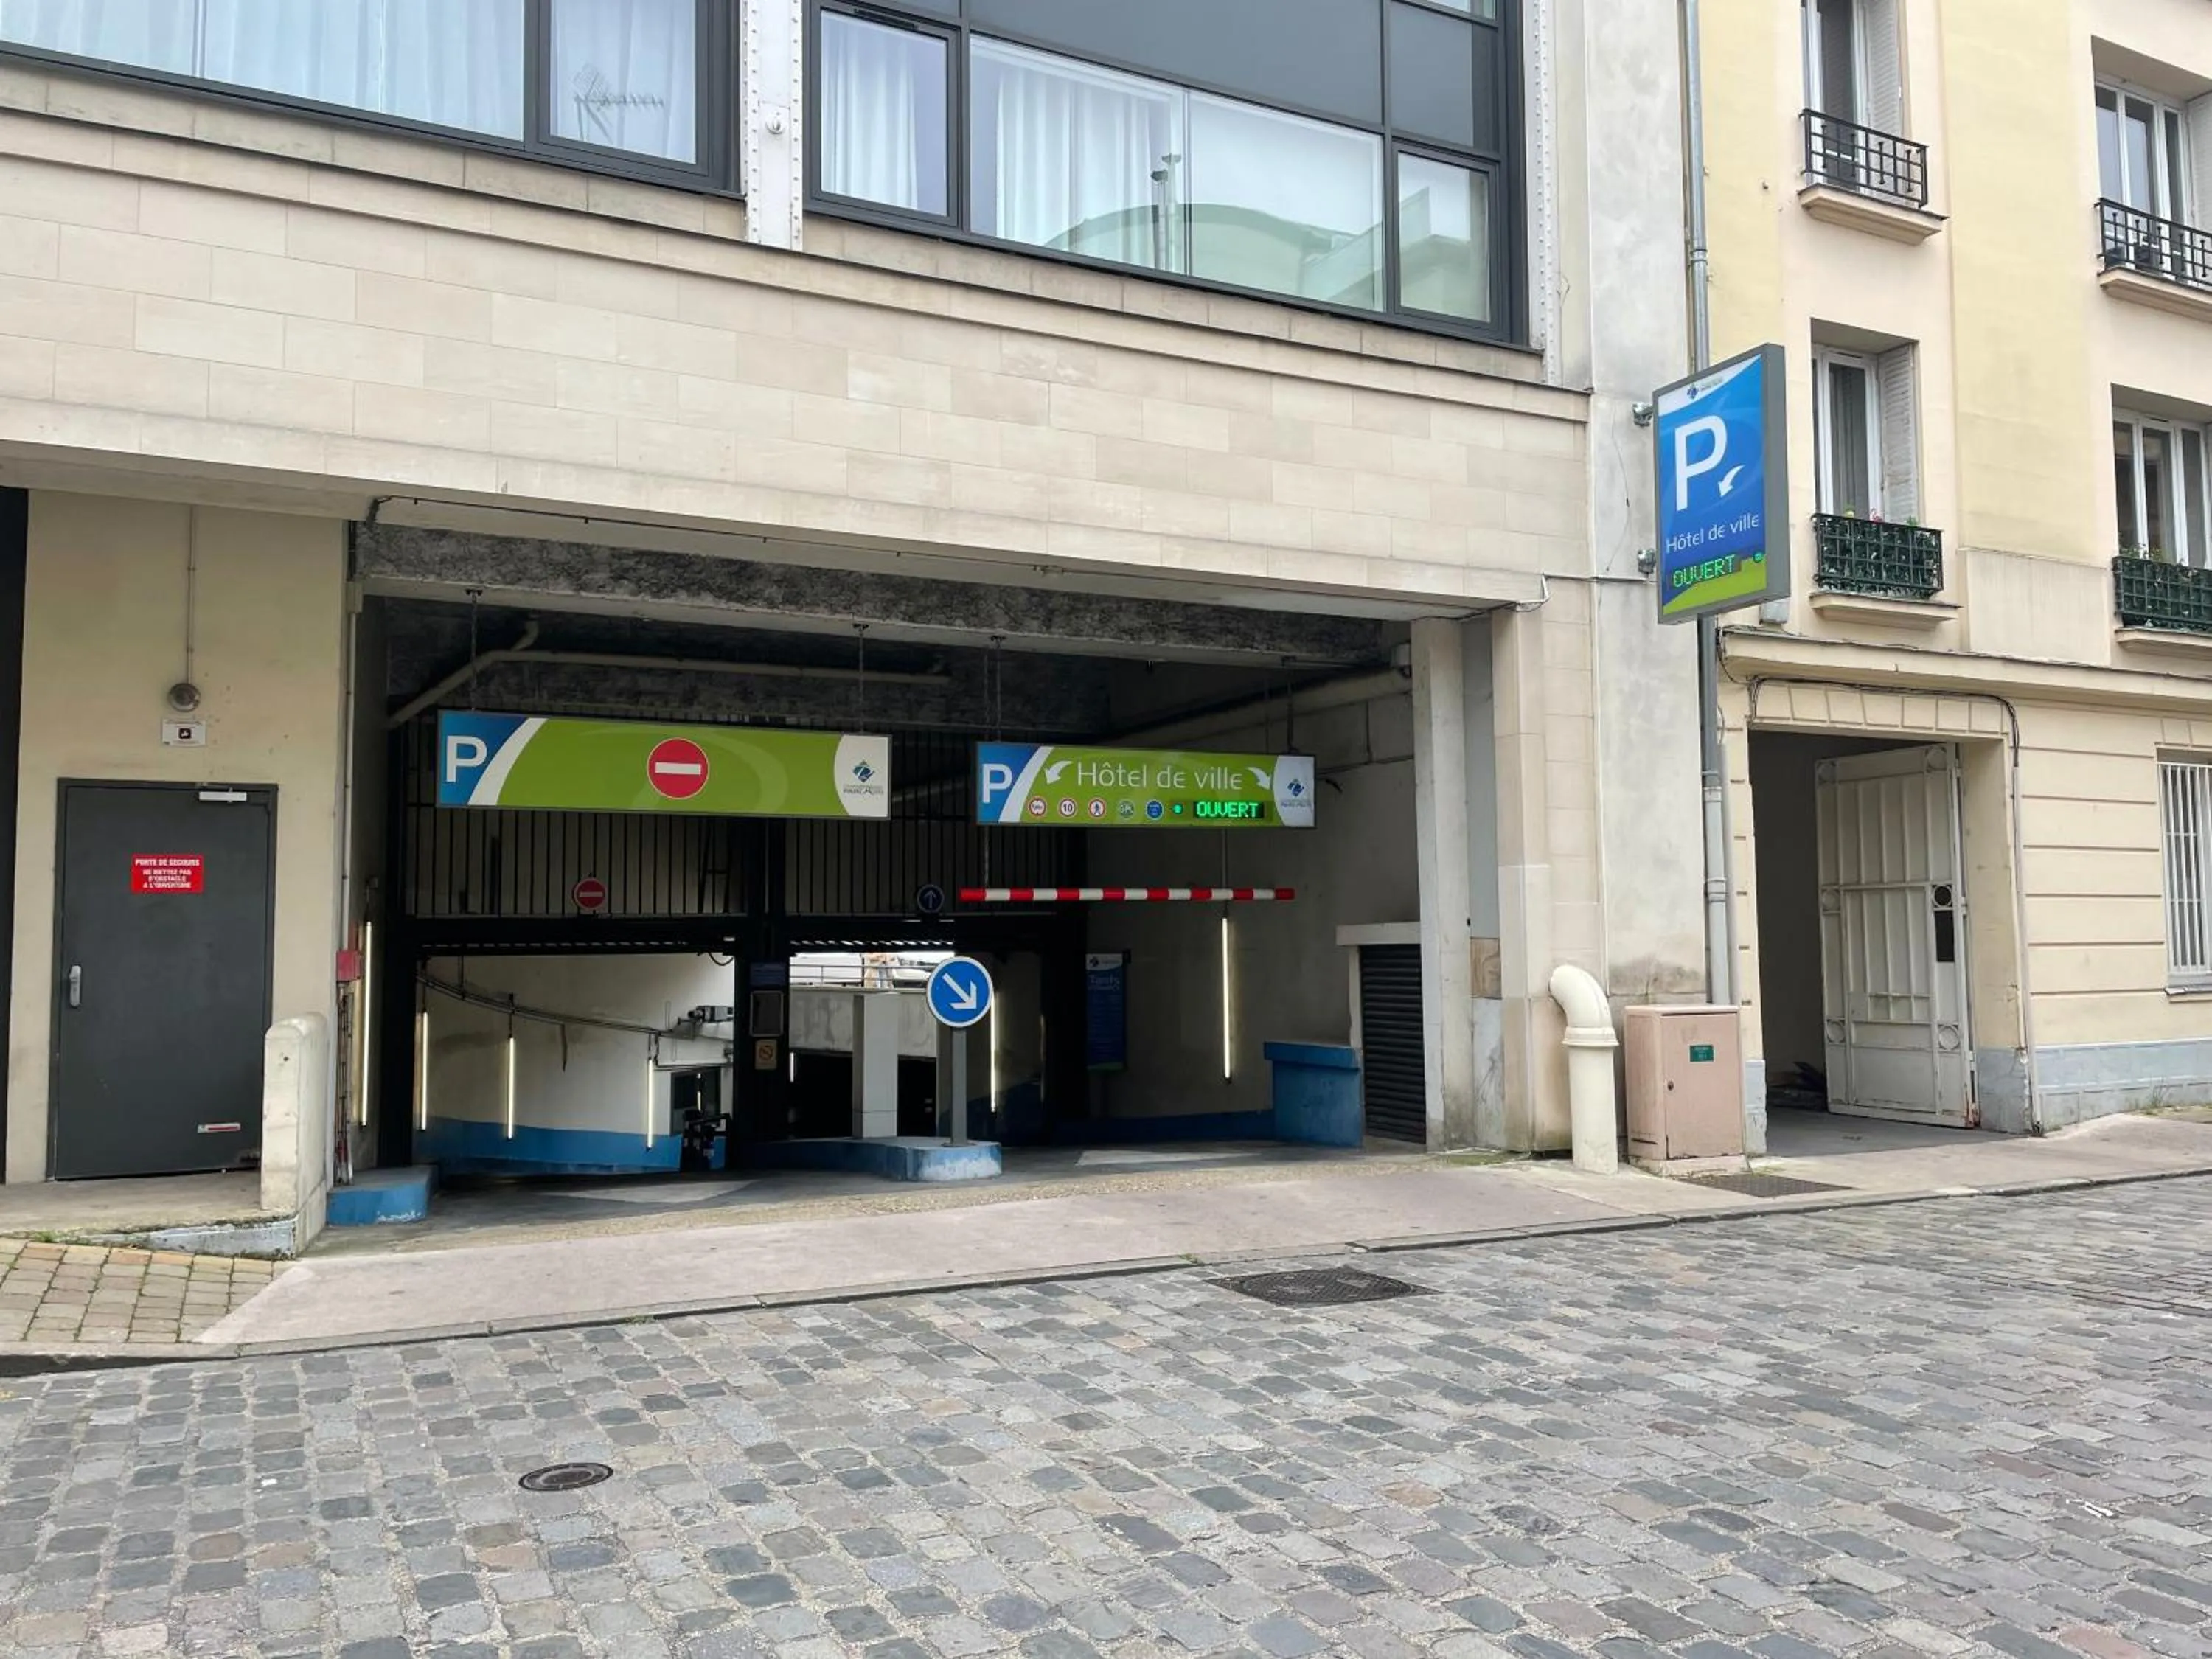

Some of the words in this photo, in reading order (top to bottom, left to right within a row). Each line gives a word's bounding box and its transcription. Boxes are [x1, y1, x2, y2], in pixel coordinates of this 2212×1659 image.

[1674, 414, 1728, 511] P
[1666, 528, 1704, 554] Hôtel
[1708, 524, 1725, 540] de
[1729, 512, 1759, 534] ville
[1673, 554, 1736, 588] OUVERT
[446, 735, 487, 782] P
[1077, 762, 1147, 787] Hôtel
[1156, 765, 1186, 789] de
[1193, 766, 1242, 790] ville
[982, 763, 1012, 803] P
[1063, 804, 1074, 813] 10
[1196, 801, 1259, 818] OUVERT
